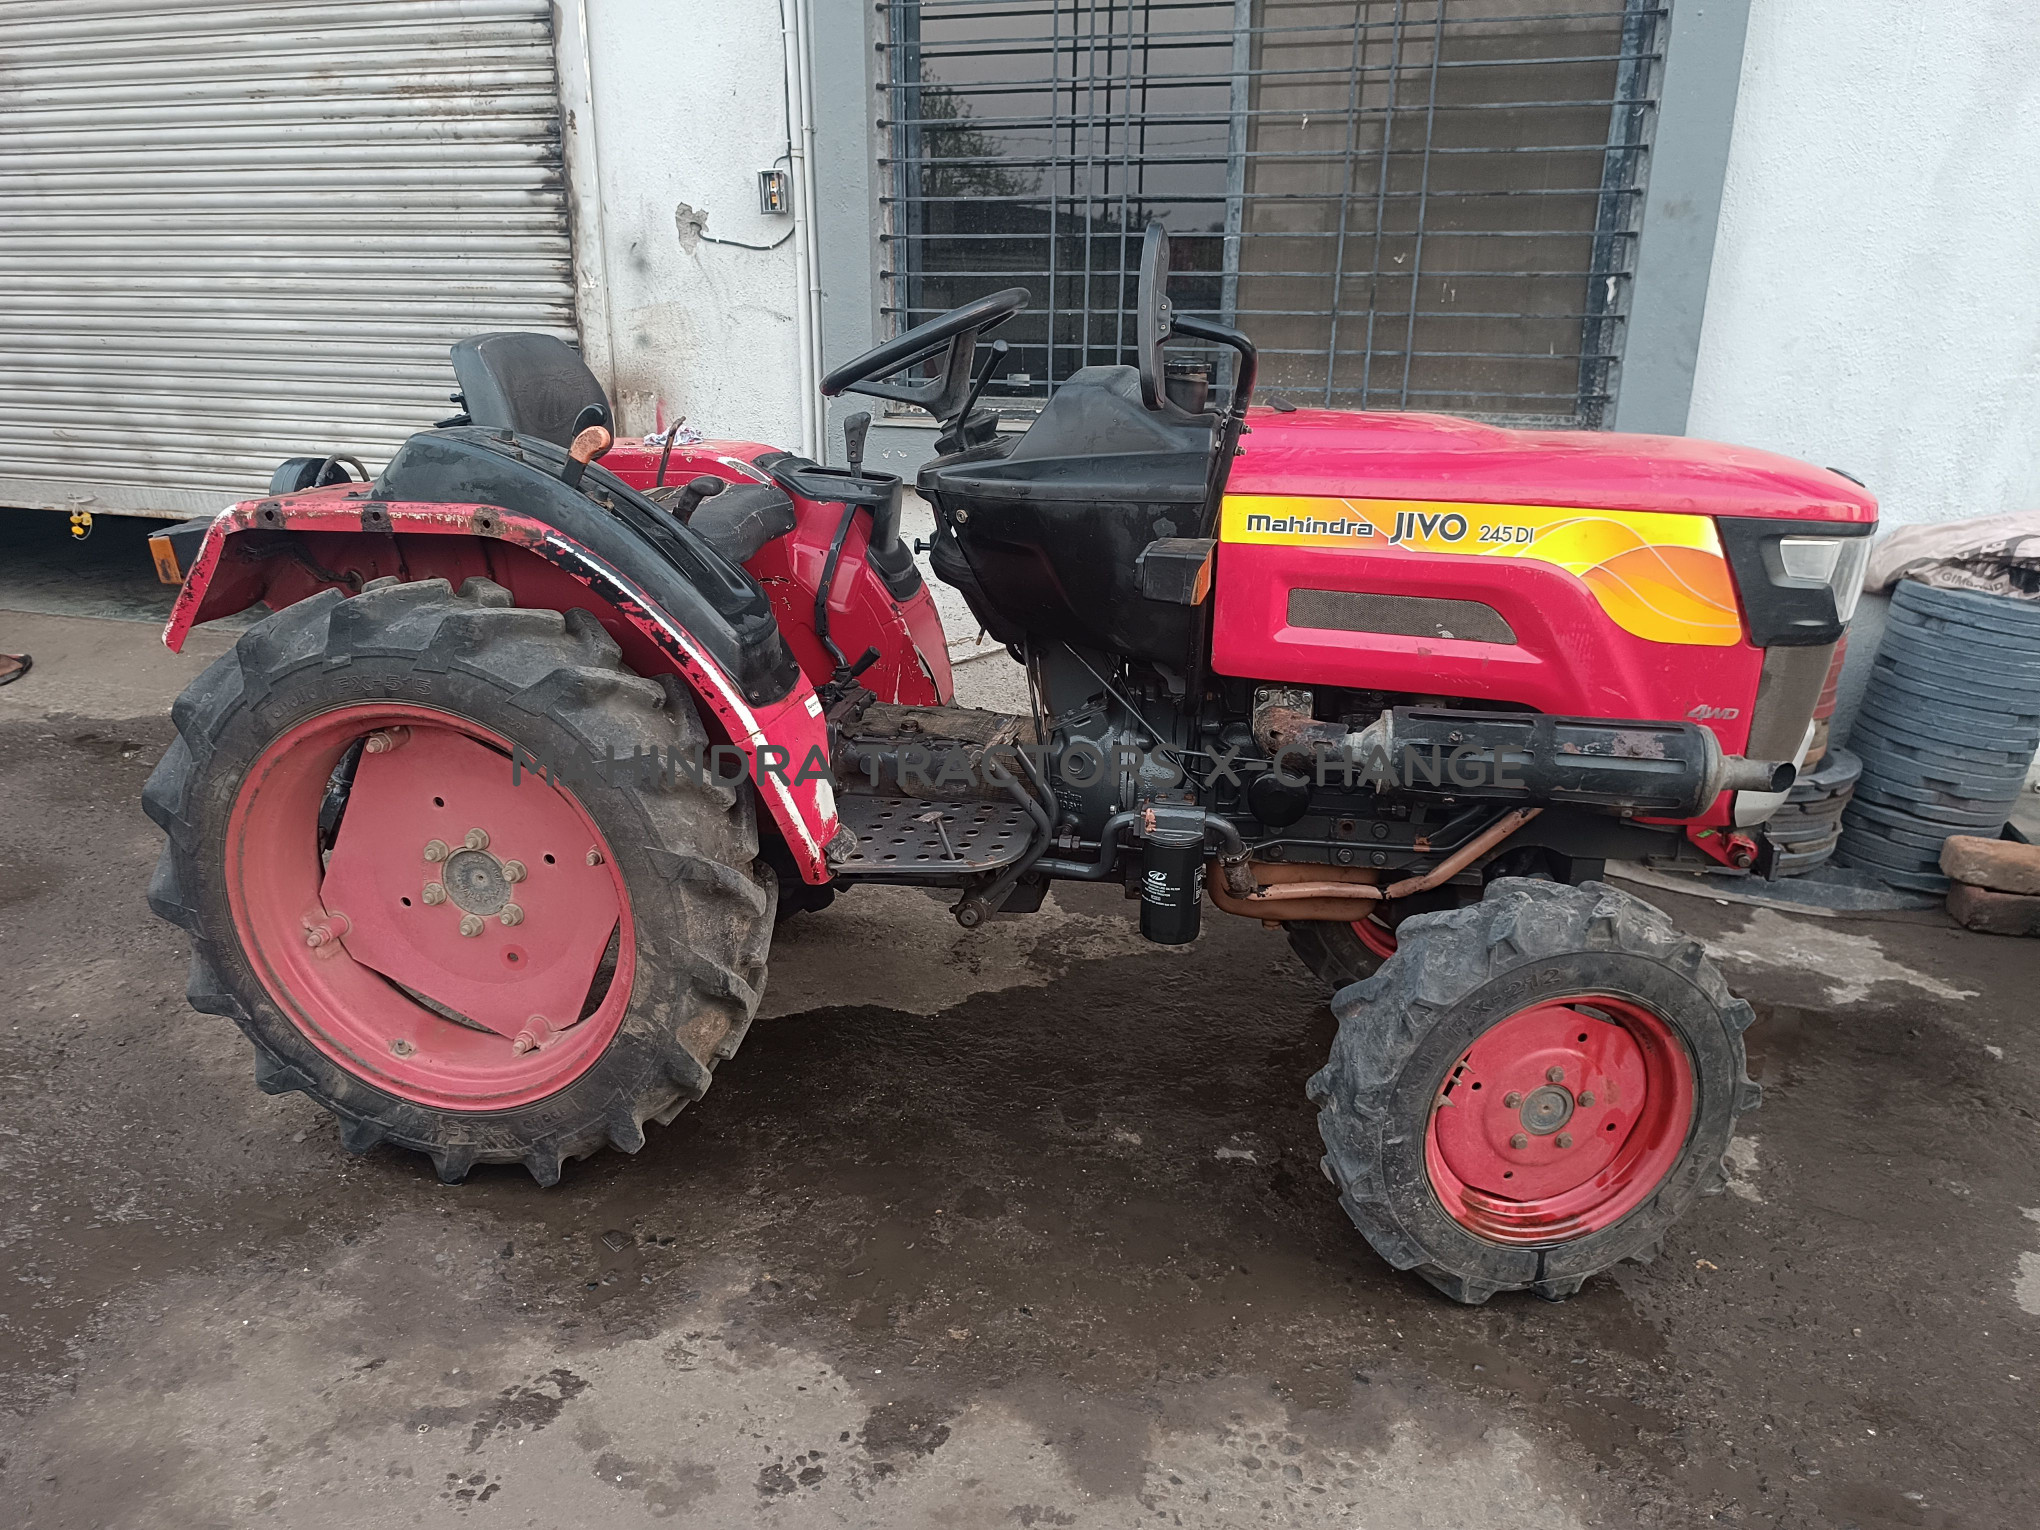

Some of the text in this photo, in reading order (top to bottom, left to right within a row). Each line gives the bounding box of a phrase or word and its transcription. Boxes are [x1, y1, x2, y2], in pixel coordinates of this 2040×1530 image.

[1247, 511, 1534, 545] Mahindra JIVO 245 DI
[333, 675, 432, 696] FX-515
[1687, 704, 1740, 721] 4WD
